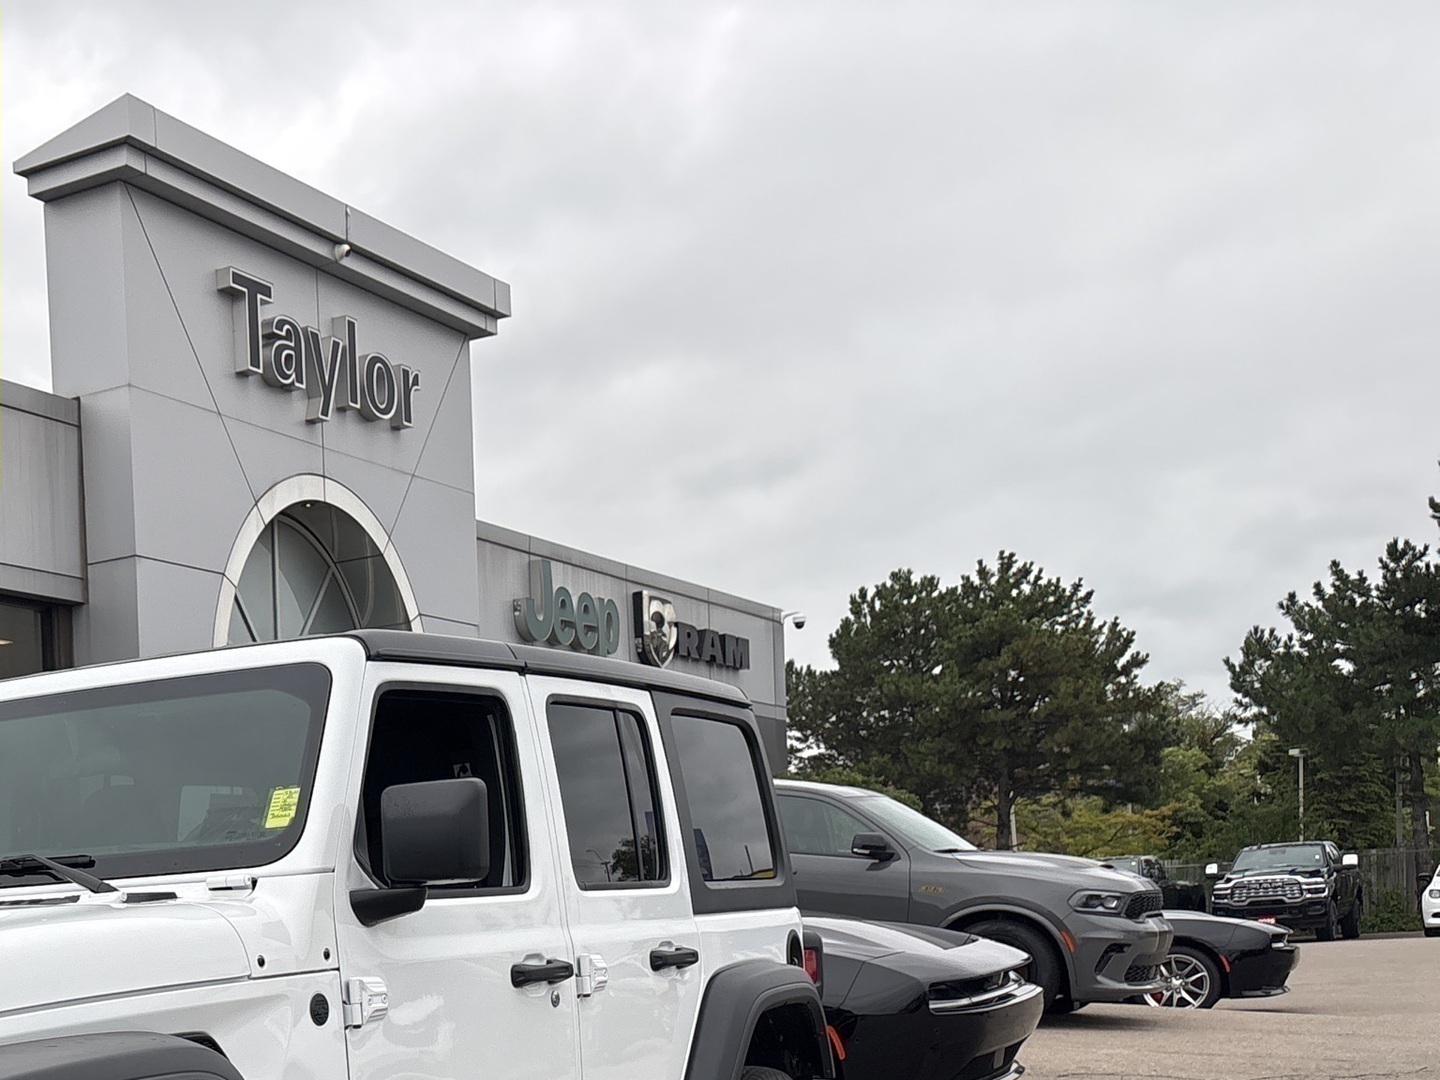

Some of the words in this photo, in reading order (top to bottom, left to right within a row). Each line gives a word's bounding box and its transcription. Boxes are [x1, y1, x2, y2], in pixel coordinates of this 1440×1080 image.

[216, 266, 421, 431] Taylor
[513, 559, 620, 657] Jeep
[674, 621, 750, 670] RAM
